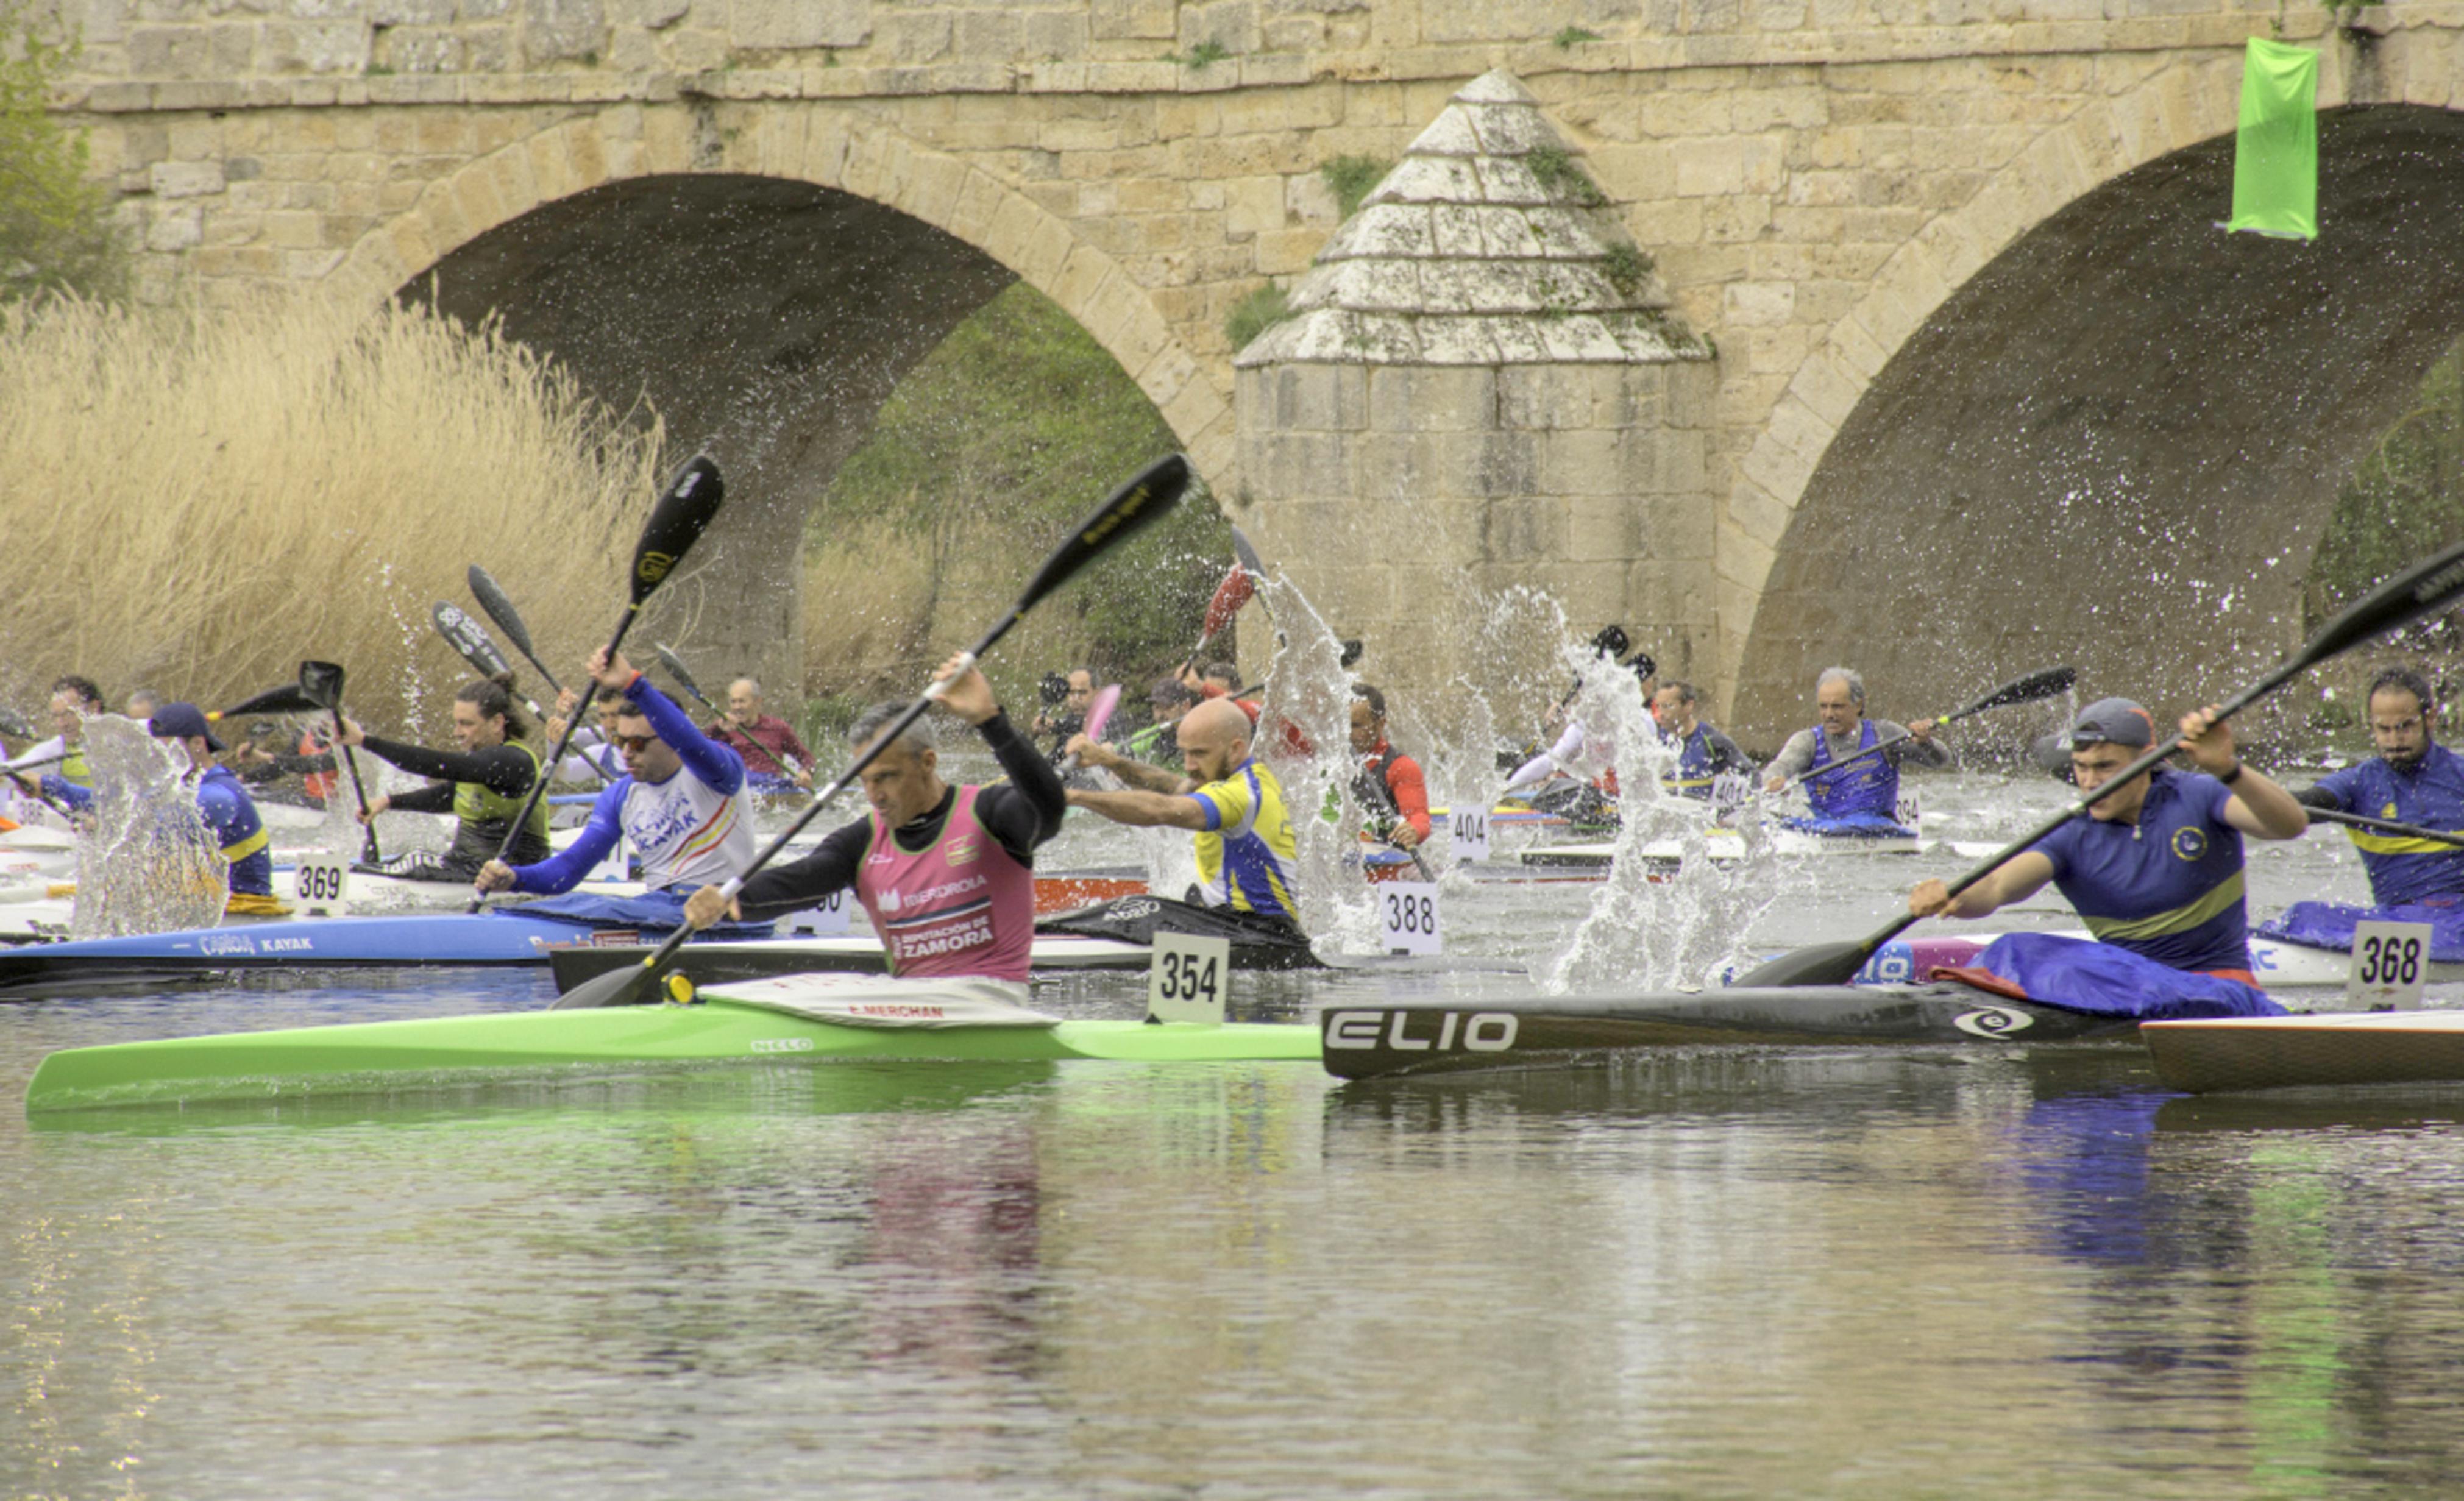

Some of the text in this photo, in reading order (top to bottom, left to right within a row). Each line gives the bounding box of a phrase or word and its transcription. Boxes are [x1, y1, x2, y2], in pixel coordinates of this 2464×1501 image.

[1455, 812, 1485, 844] 404
[299, 865, 341, 901] 369
[1387, 893, 1435, 935] 388
[260, 937, 313, 952] KAYAK
[903, 927, 993, 958] ZAMORA
[2360, 935, 2421, 985] 368
[1160, 951, 1217, 1003] 354
[1325, 1011, 1519, 1051] ELIO
